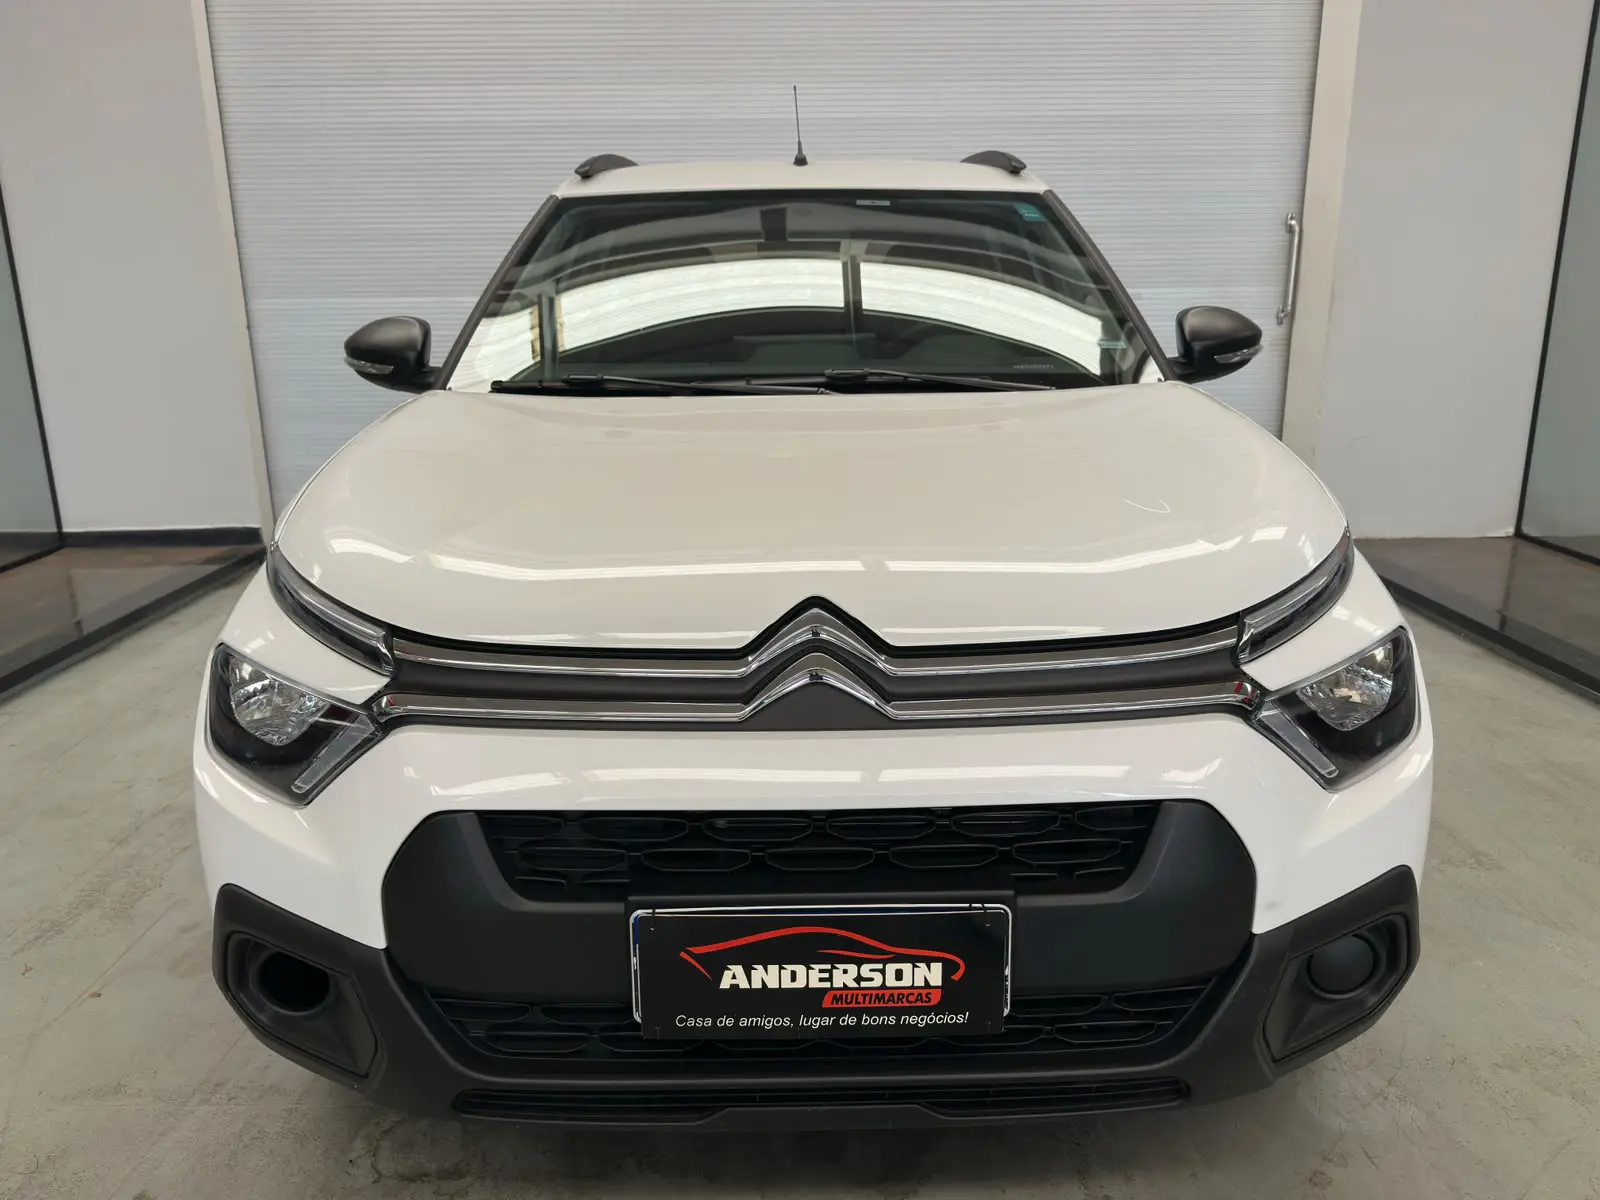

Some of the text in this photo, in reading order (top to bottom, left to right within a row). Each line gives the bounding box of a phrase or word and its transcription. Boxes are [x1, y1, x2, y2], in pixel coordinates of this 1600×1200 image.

[719, 963, 943, 988] ANDERSON
[830, 992, 933, 1006] MULTIMARCAS
[675, 1011, 970, 1030] Casa de amigos, lugar de bons negócios!
